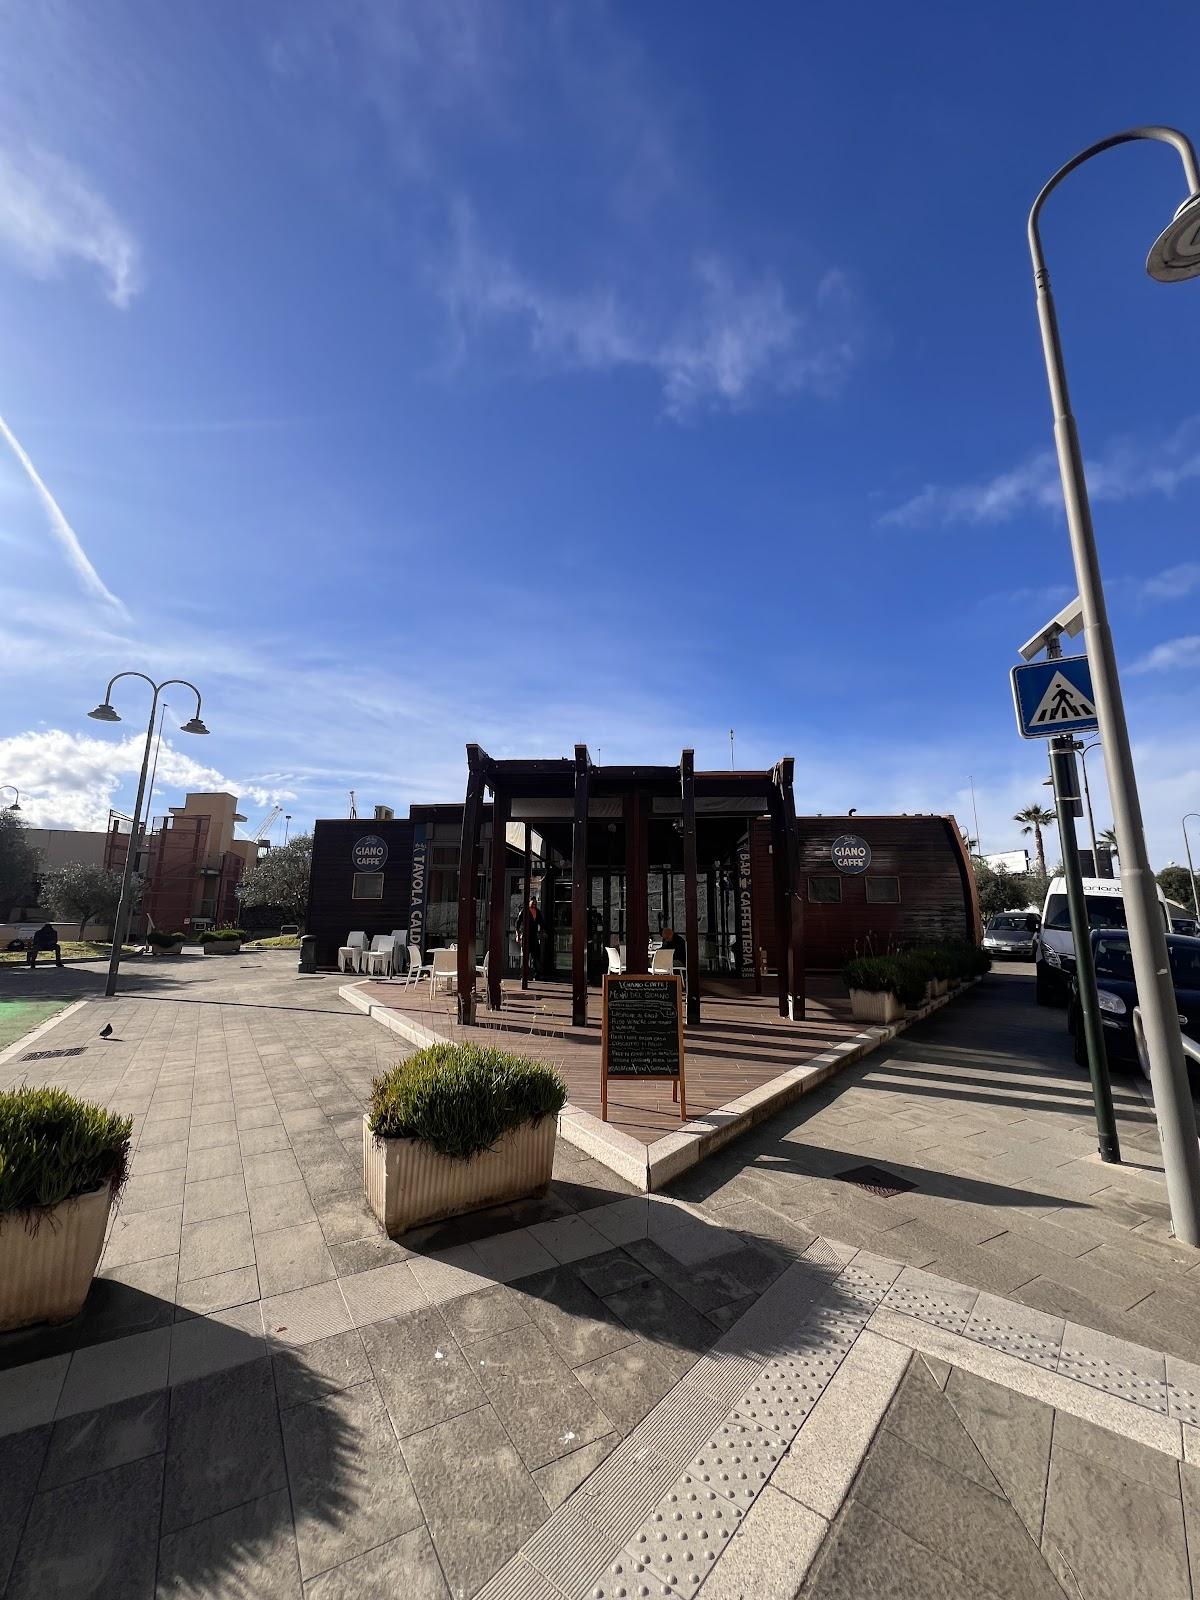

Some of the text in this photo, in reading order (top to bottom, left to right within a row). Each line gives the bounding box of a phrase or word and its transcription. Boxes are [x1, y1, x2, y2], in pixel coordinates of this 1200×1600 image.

[355, 846, 383, 856] GIANO
[834, 847, 866, 857] GIANO
[739, 853, 751, 876] BAR
[409, 855, 425, 948] TAVOLA CALD
[740, 891, 753, 965] CAFFETTERIA
